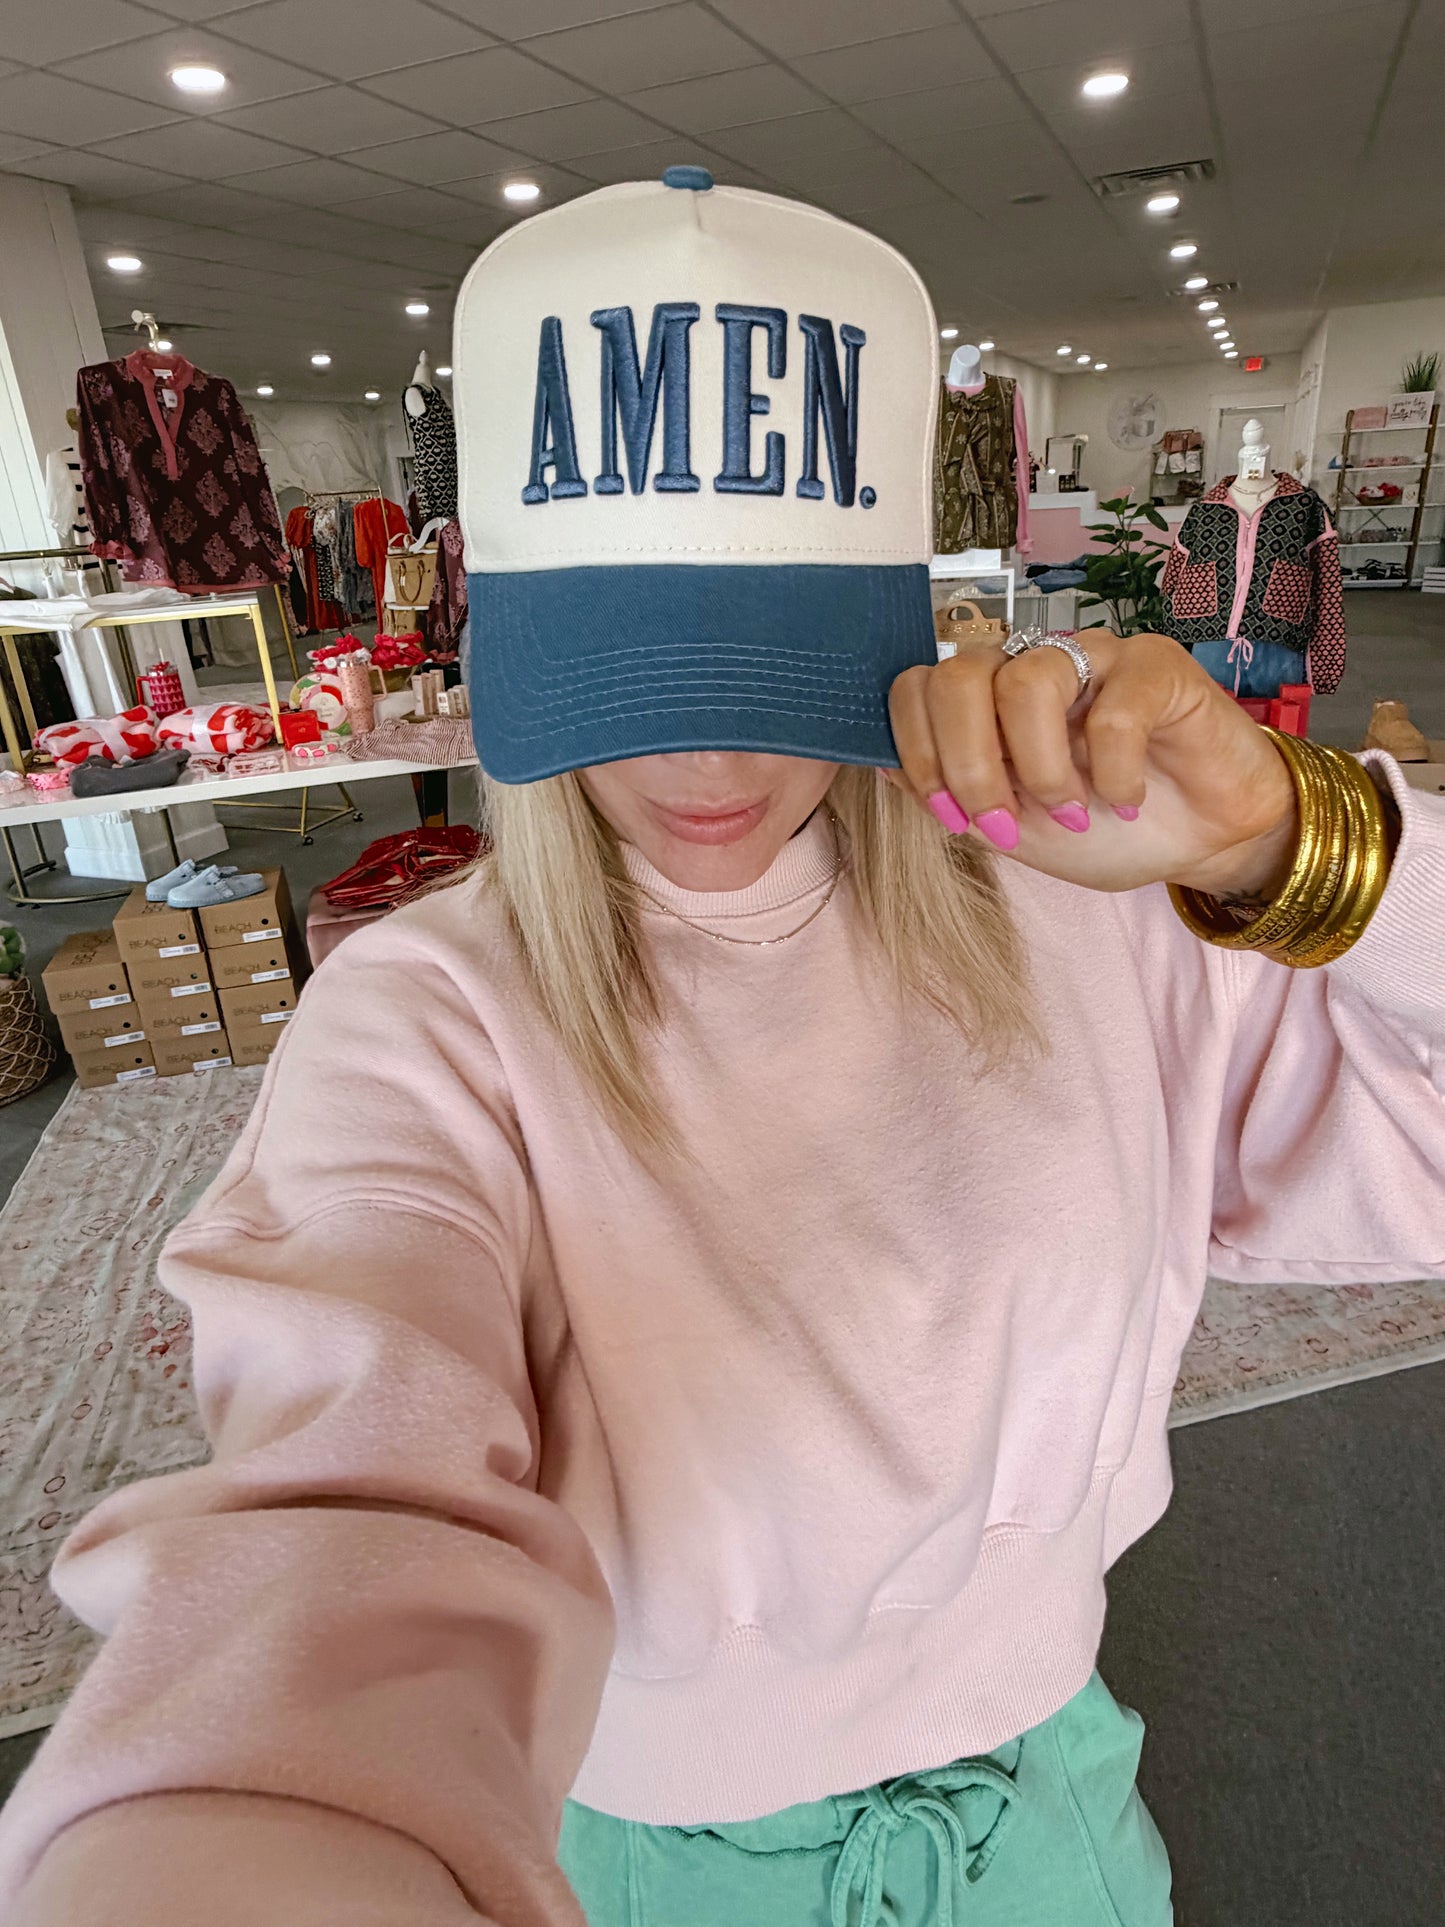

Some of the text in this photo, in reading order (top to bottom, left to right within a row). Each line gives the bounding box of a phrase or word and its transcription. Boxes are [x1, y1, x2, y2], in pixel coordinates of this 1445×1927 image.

[521, 302, 877, 509] AMEN.
[214, 922, 252, 935] BEACH
[128, 936, 168, 949] BEACH
[223, 964, 260, 976] BEACH
[142, 977, 181, 989] BEACH
[58, 988, 98, 1001] BEACH
[232, 1004, 270, 1017] BEACH
[153, 1016, 191, 1028] BEACH
[75, 1027, 114, 1040] BEACH
[166, 1052, 204, 1064] BEACH
